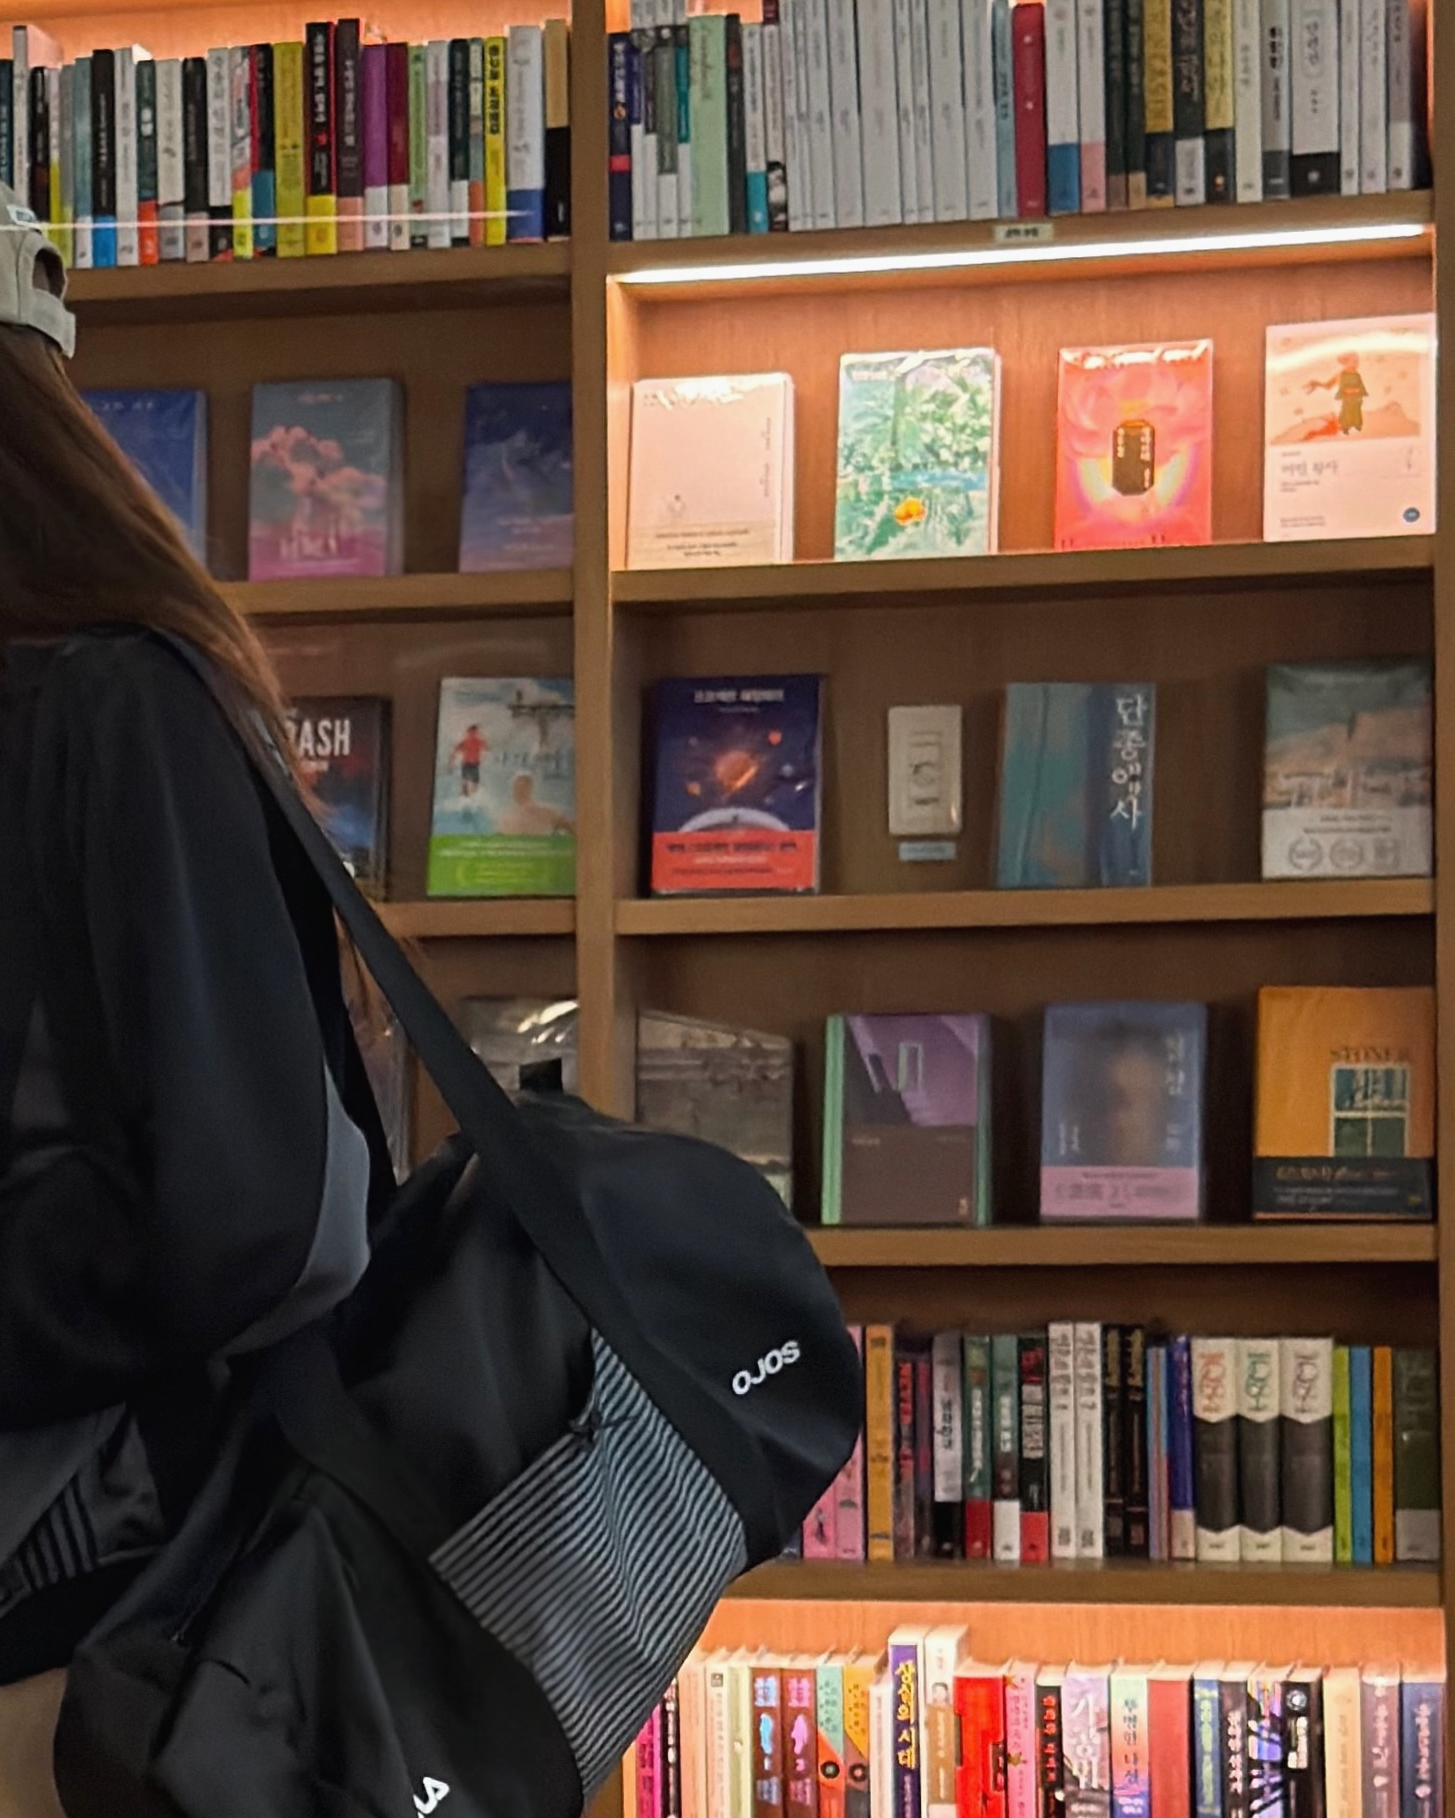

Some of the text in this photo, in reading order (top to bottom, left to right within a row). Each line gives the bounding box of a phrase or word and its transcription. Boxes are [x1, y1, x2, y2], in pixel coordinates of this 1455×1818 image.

[1110, 694, 1146, 830] 단종애사
[732, 1340, 800, 1395] OJOS
[1123, 1698, 1138, 1746] 투명한
[897, 1726, 915, 1770] 시대
